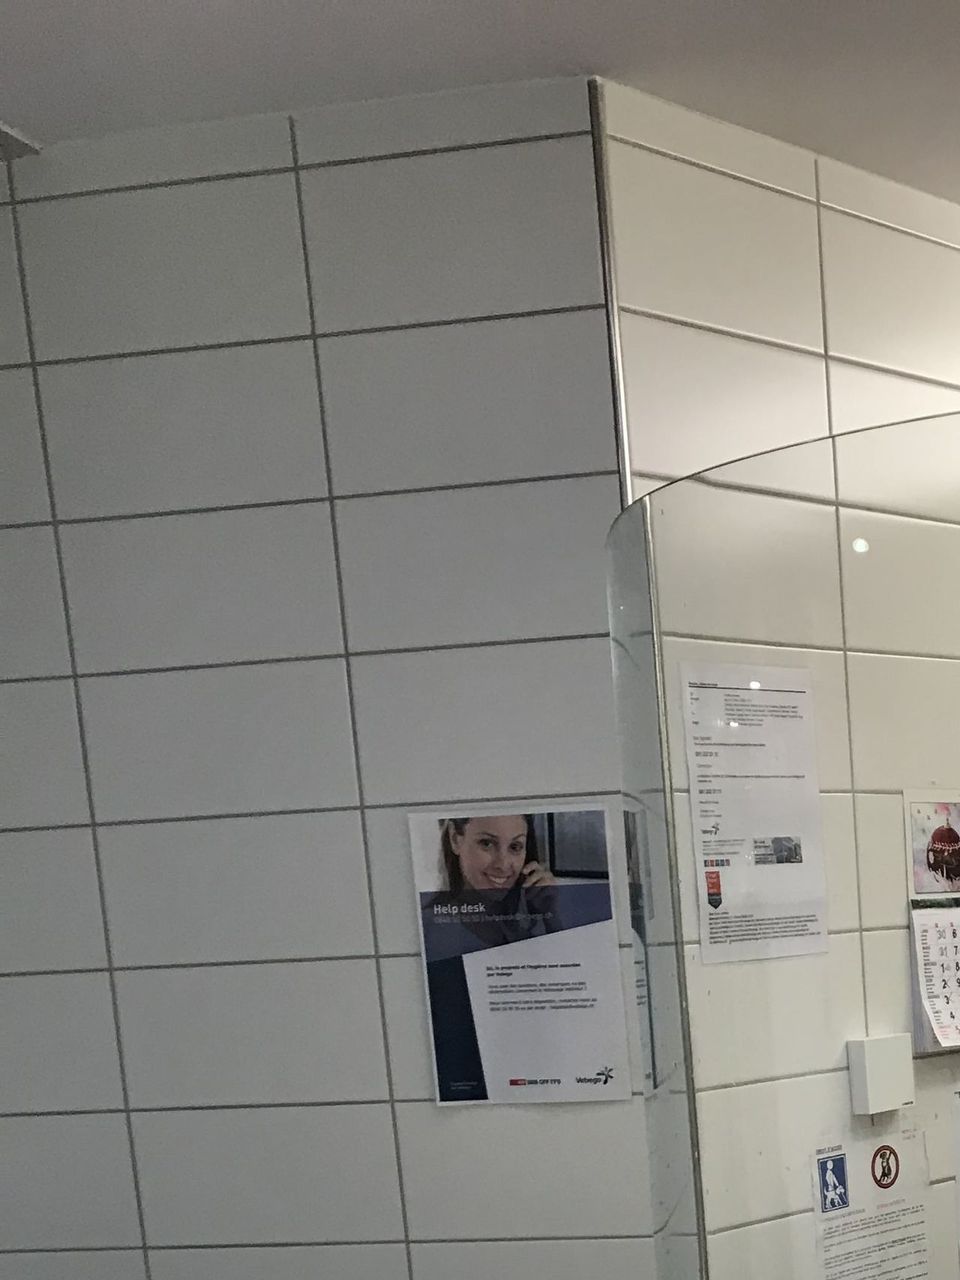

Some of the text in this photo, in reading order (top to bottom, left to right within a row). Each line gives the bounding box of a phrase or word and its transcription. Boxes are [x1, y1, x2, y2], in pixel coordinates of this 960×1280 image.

[433, 902, 486, 915] Help desk
[952, 929, 957, 939] 6
[954, 945, 958, 956] 7
[955, 962, 960, 972] 8
[956, 978, 960, 988] 9
[950, 1011, 955, 1020] 4
